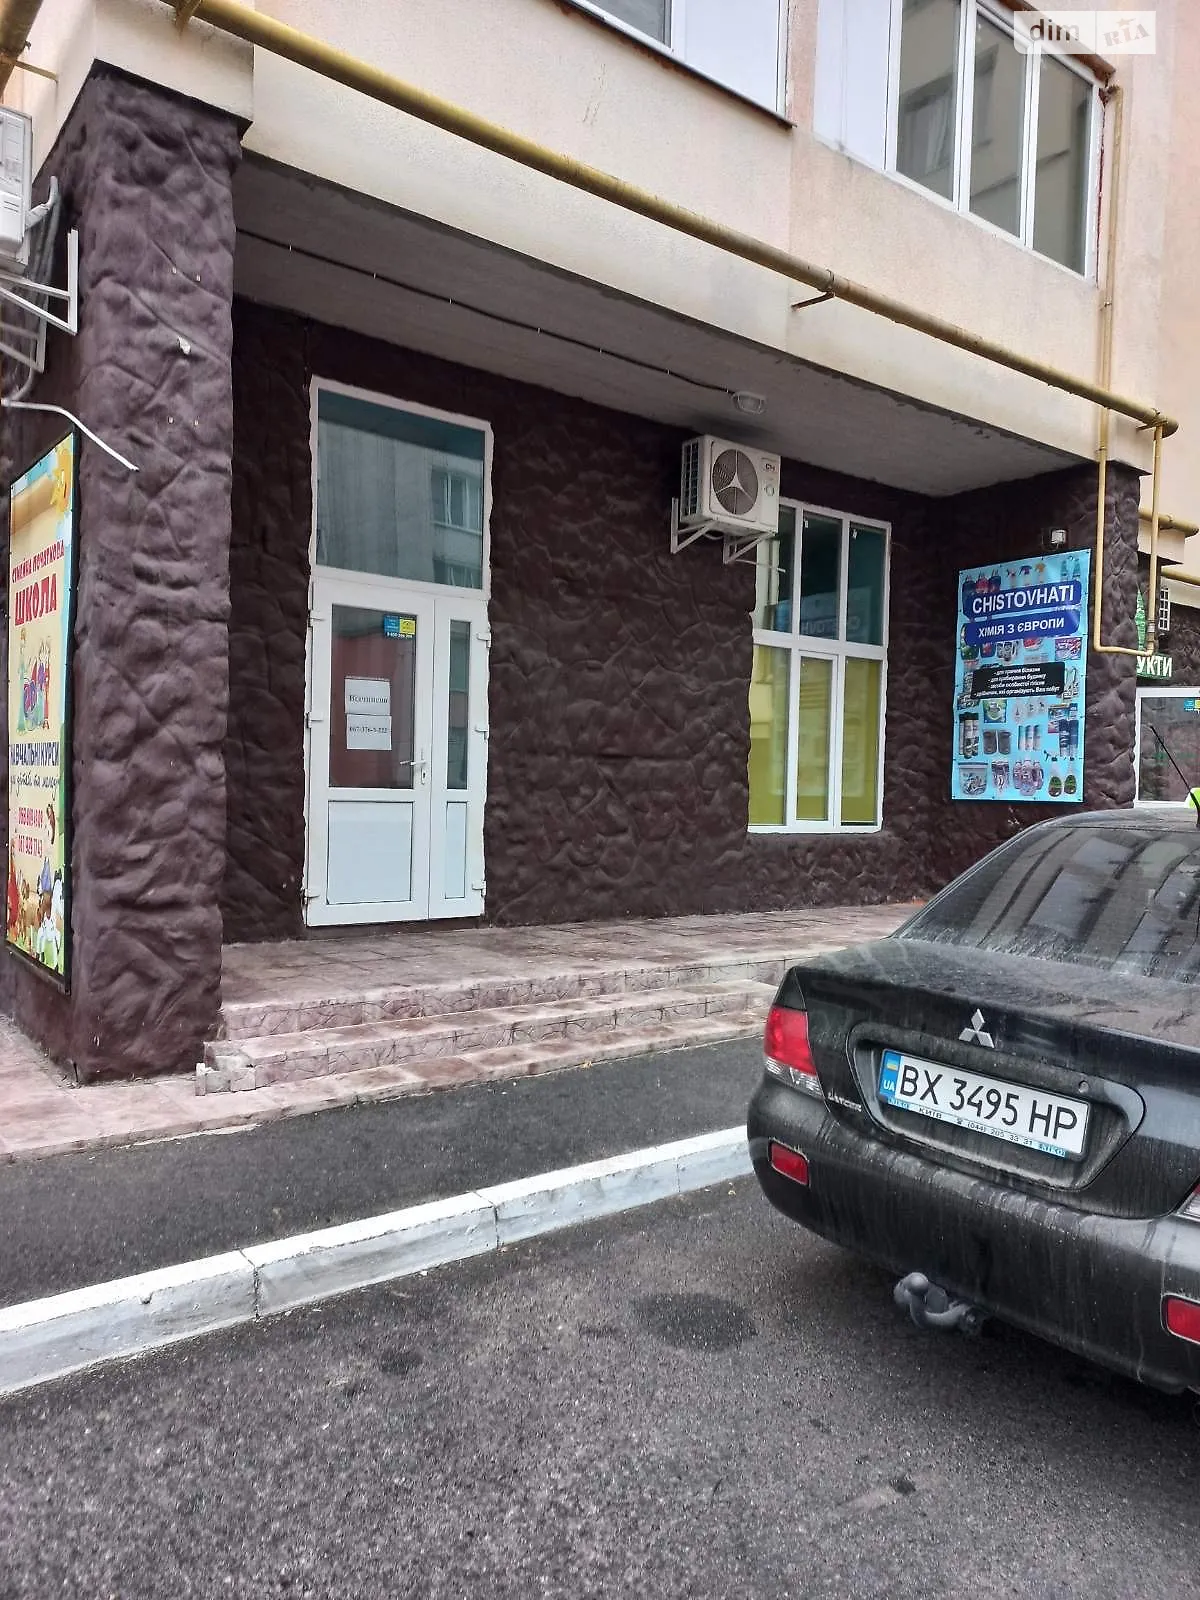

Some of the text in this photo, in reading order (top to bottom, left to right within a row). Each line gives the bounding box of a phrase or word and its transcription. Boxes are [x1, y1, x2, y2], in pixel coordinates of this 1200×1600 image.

[33, 539, 65, 572] ПОЧАТКОВА
[15, 573, 57, 626] ШКОЛА
[972, 584, 1074, 614] CHISTOVHATI
[978, 617, 1065, 639] ХІМІЯ З ЄВРОПИ
[41, 742, 60, 766] КУРСИ
[883, 1079, 895, 1091] UA
[900, 1064, 1078, 1139] BX 3495 HP
